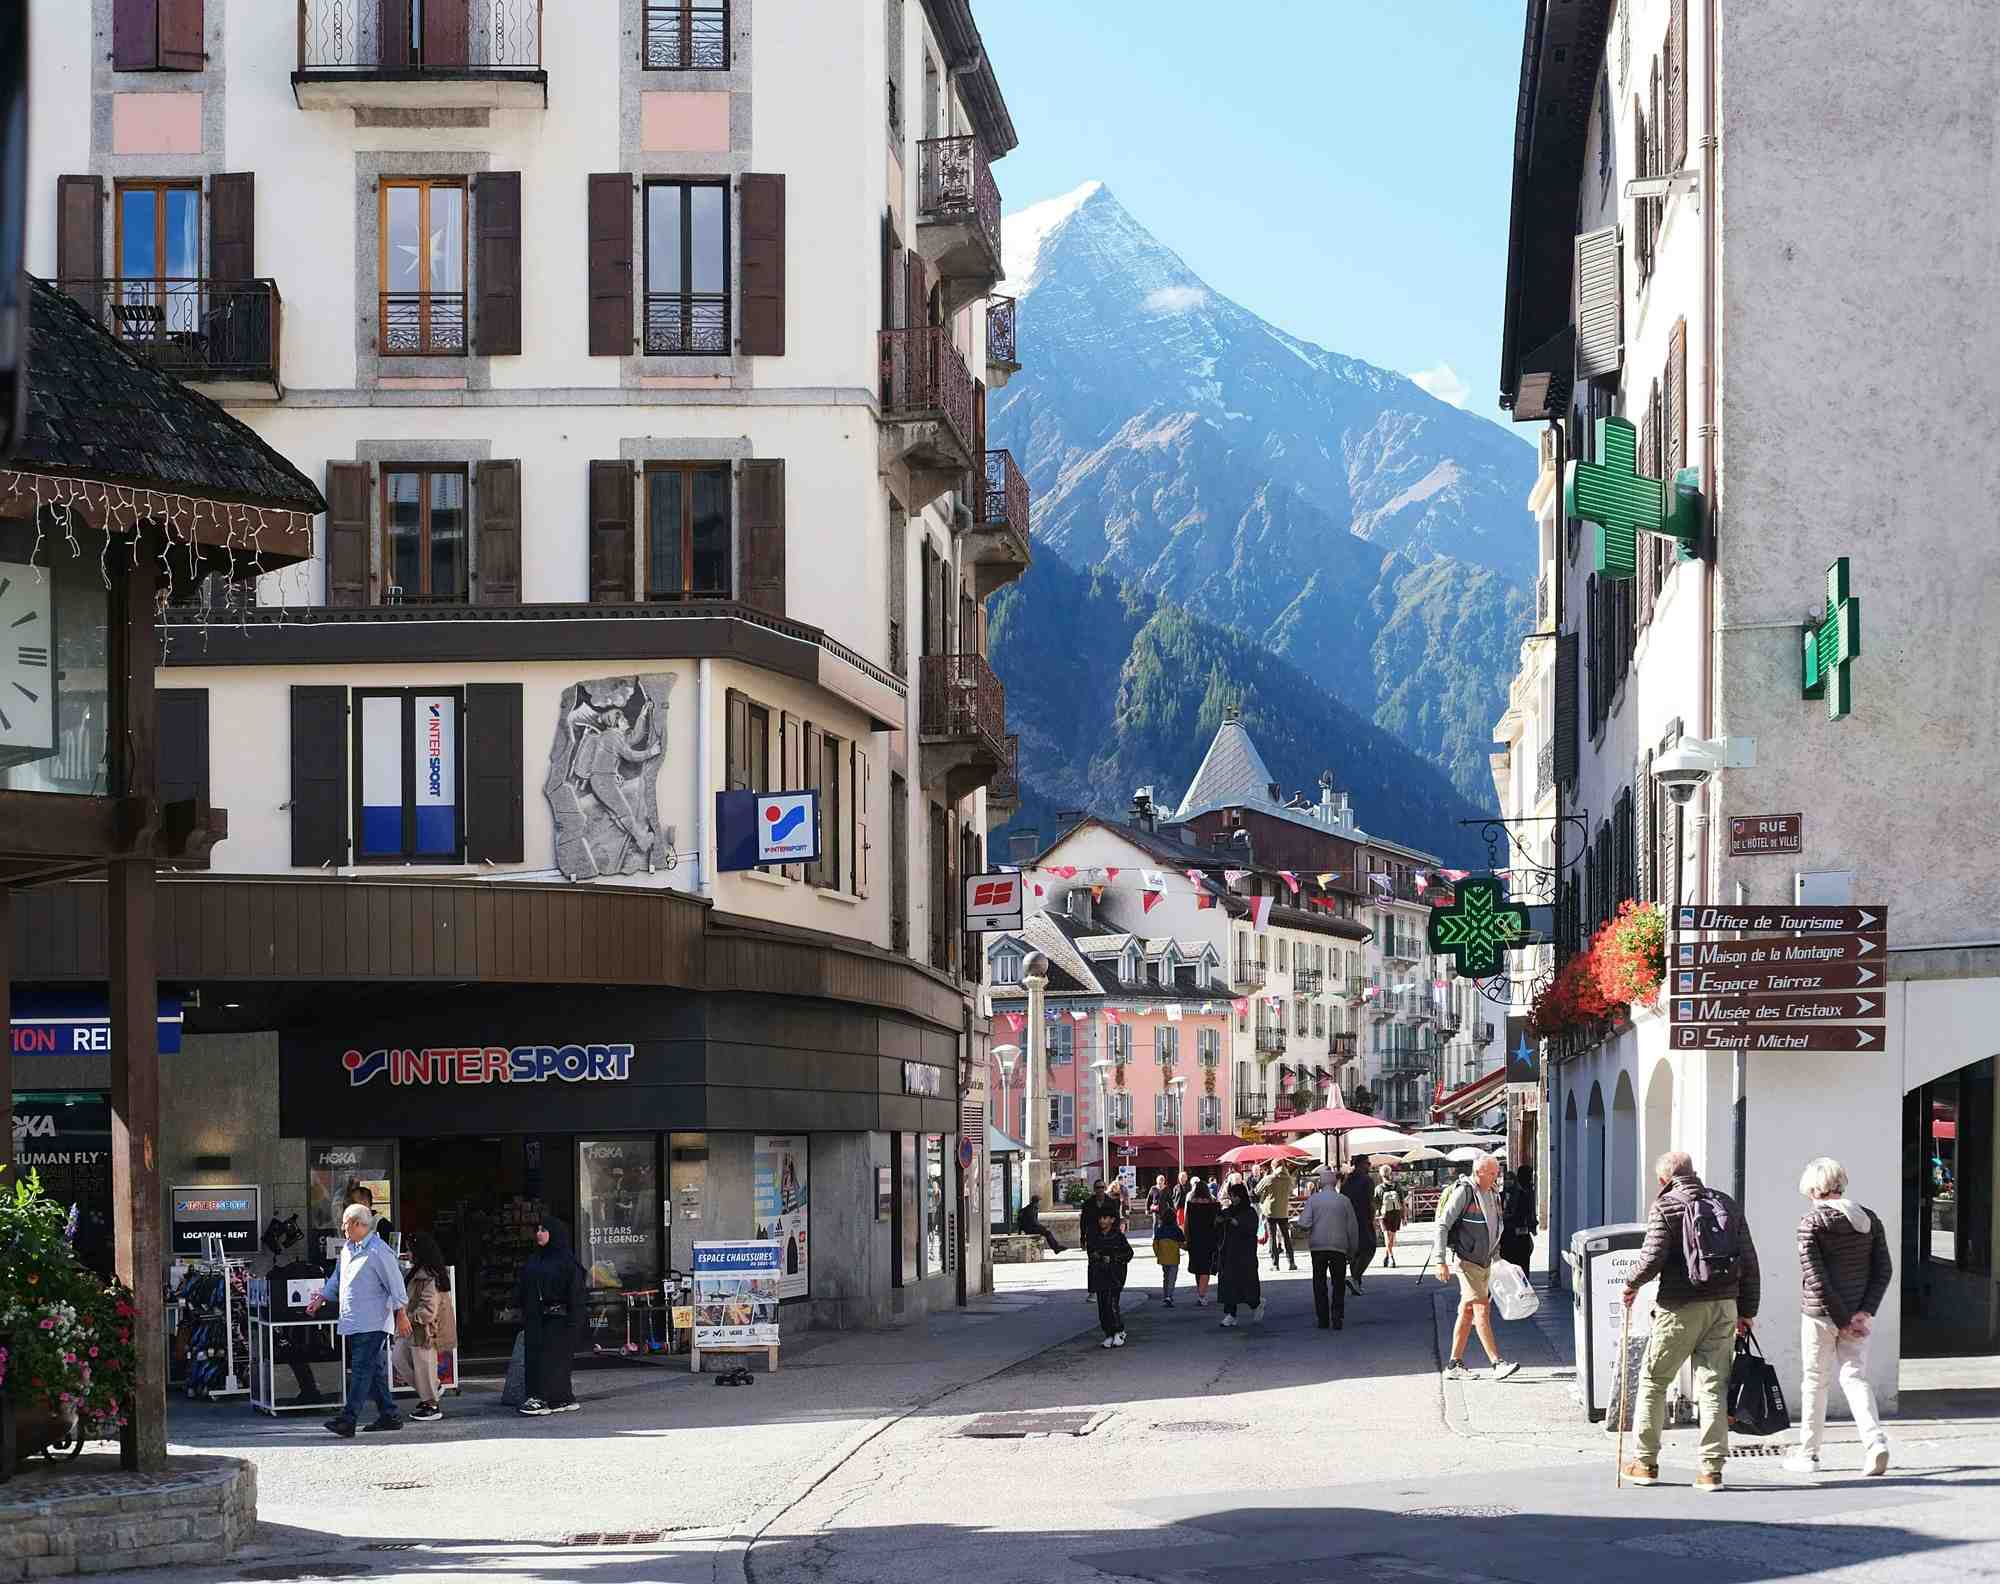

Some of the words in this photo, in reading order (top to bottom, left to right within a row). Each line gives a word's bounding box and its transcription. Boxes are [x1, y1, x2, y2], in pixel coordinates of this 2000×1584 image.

[429, 719, 441, 797] INTERSPORT
[1760, 820, 1787, 833] RUE
[1779, 835, 1799, 847] VILLE
[1700, 909, 1749, 929] Office
[1754, 916, 1773, 929] de
[1780, 915, 1844, 929] Tourisme
[1699, 944, 1747, 964] Maison
[1751, 949, 1766, 962] de
[1770, 947, 1781, 961] la
[1785, 945, 1845, 960] Montagne
[1699, 971, 1759, 993] Espace
[1767, 975, 1822, 989] Tairraz
[1698, 1000, 1750, 1020] Musée
[1755, 1004, 1780, 1018] des
[1785, 1003, 1843, 1018] Cristaux
[11, 1028, 56, 1051] ION
[1703, 1028, 1751, 1048] Saint
[1757, 1034, 1809, 1048] Michel
[390, 1044, 634, 1085] INTERSPORT
[603, 1226, 632, 1235] YEARS
[698, 1253, 725, 1263] ESPACE
[727, 1252, 773, 1262] CHAUSSURES
